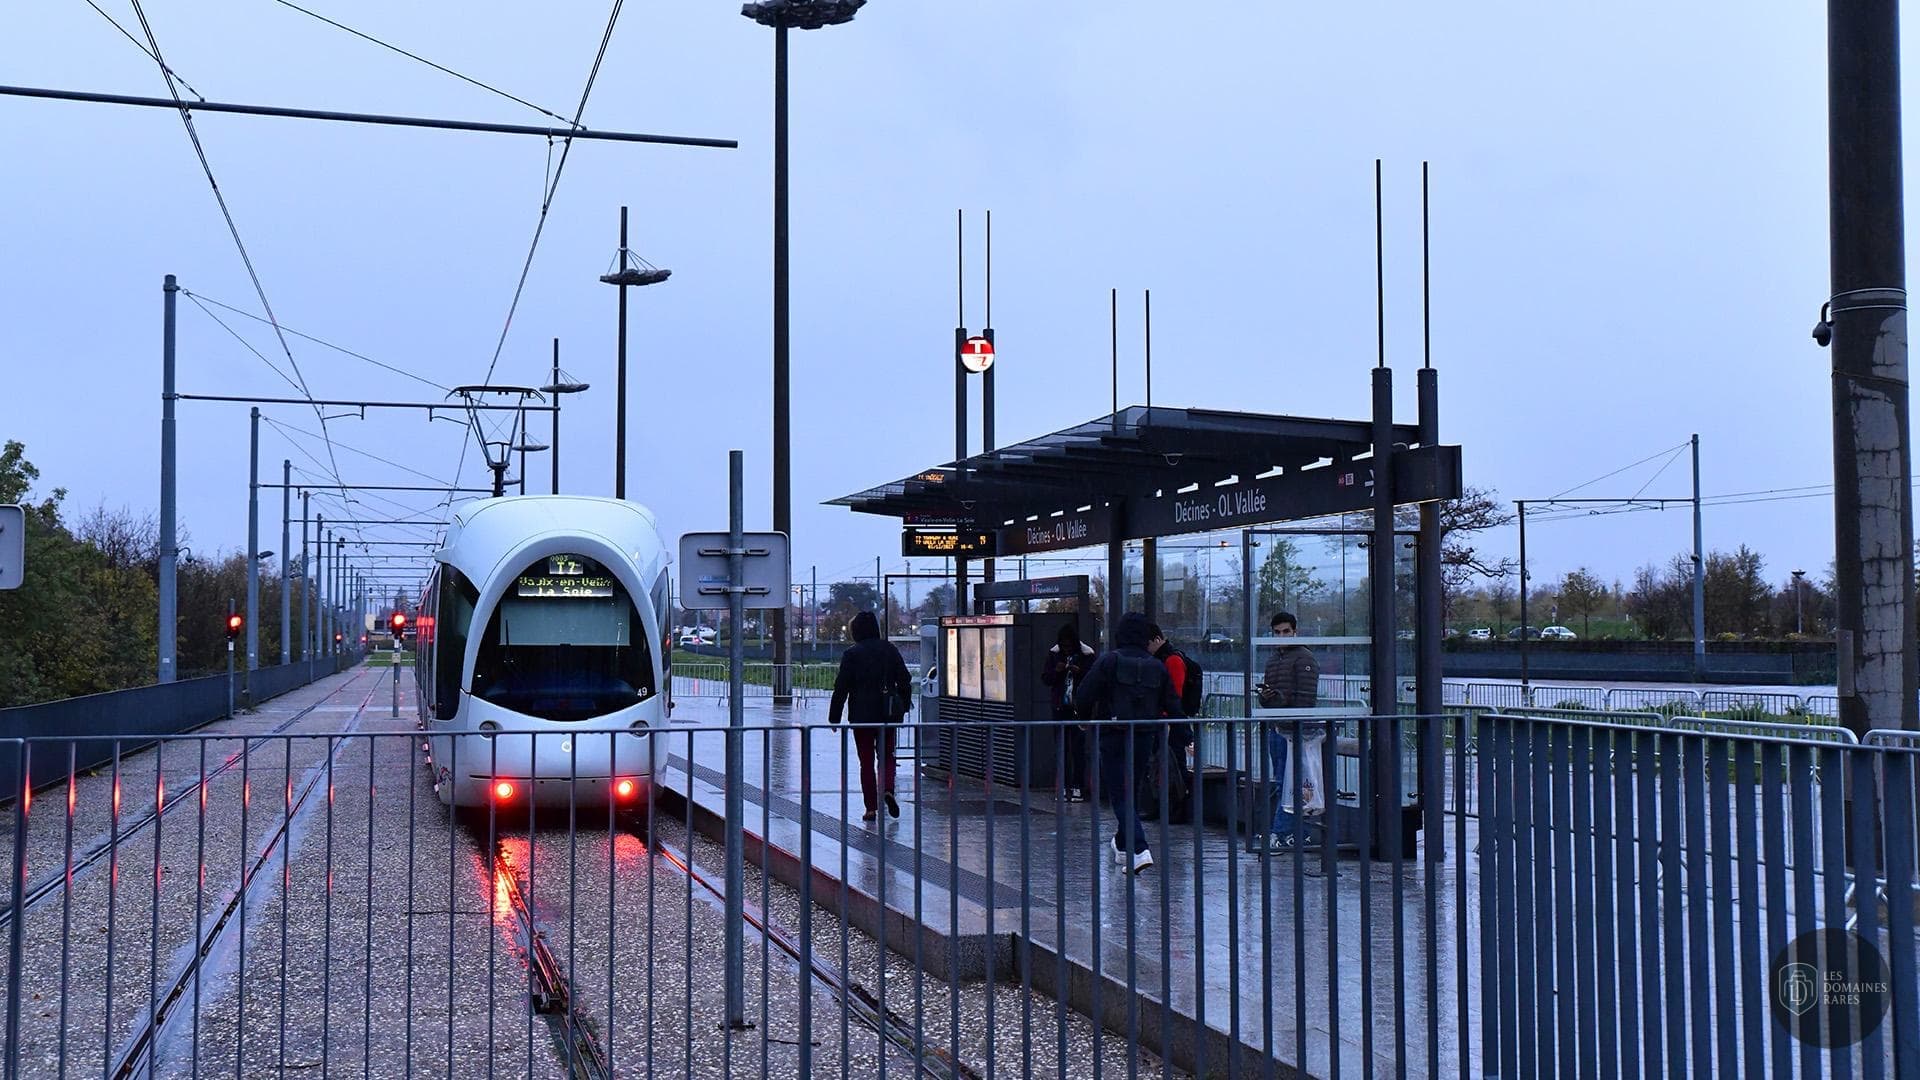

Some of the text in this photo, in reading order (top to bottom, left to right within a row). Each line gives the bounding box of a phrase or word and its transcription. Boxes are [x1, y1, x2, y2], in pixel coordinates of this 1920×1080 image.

[968, 339, 988, 354] T
[1175, 500, 1210, 523] Décines
[1218, 493, 1233, 518] OL
[1235, 488, 1266, 515] Vallée
[1027, 527, 1051, 545] Décines
[1056, 523, 1066, 541] OL
[1066, 519, 1087, 540] Vallée
[637, 686, 648, 697] 49
